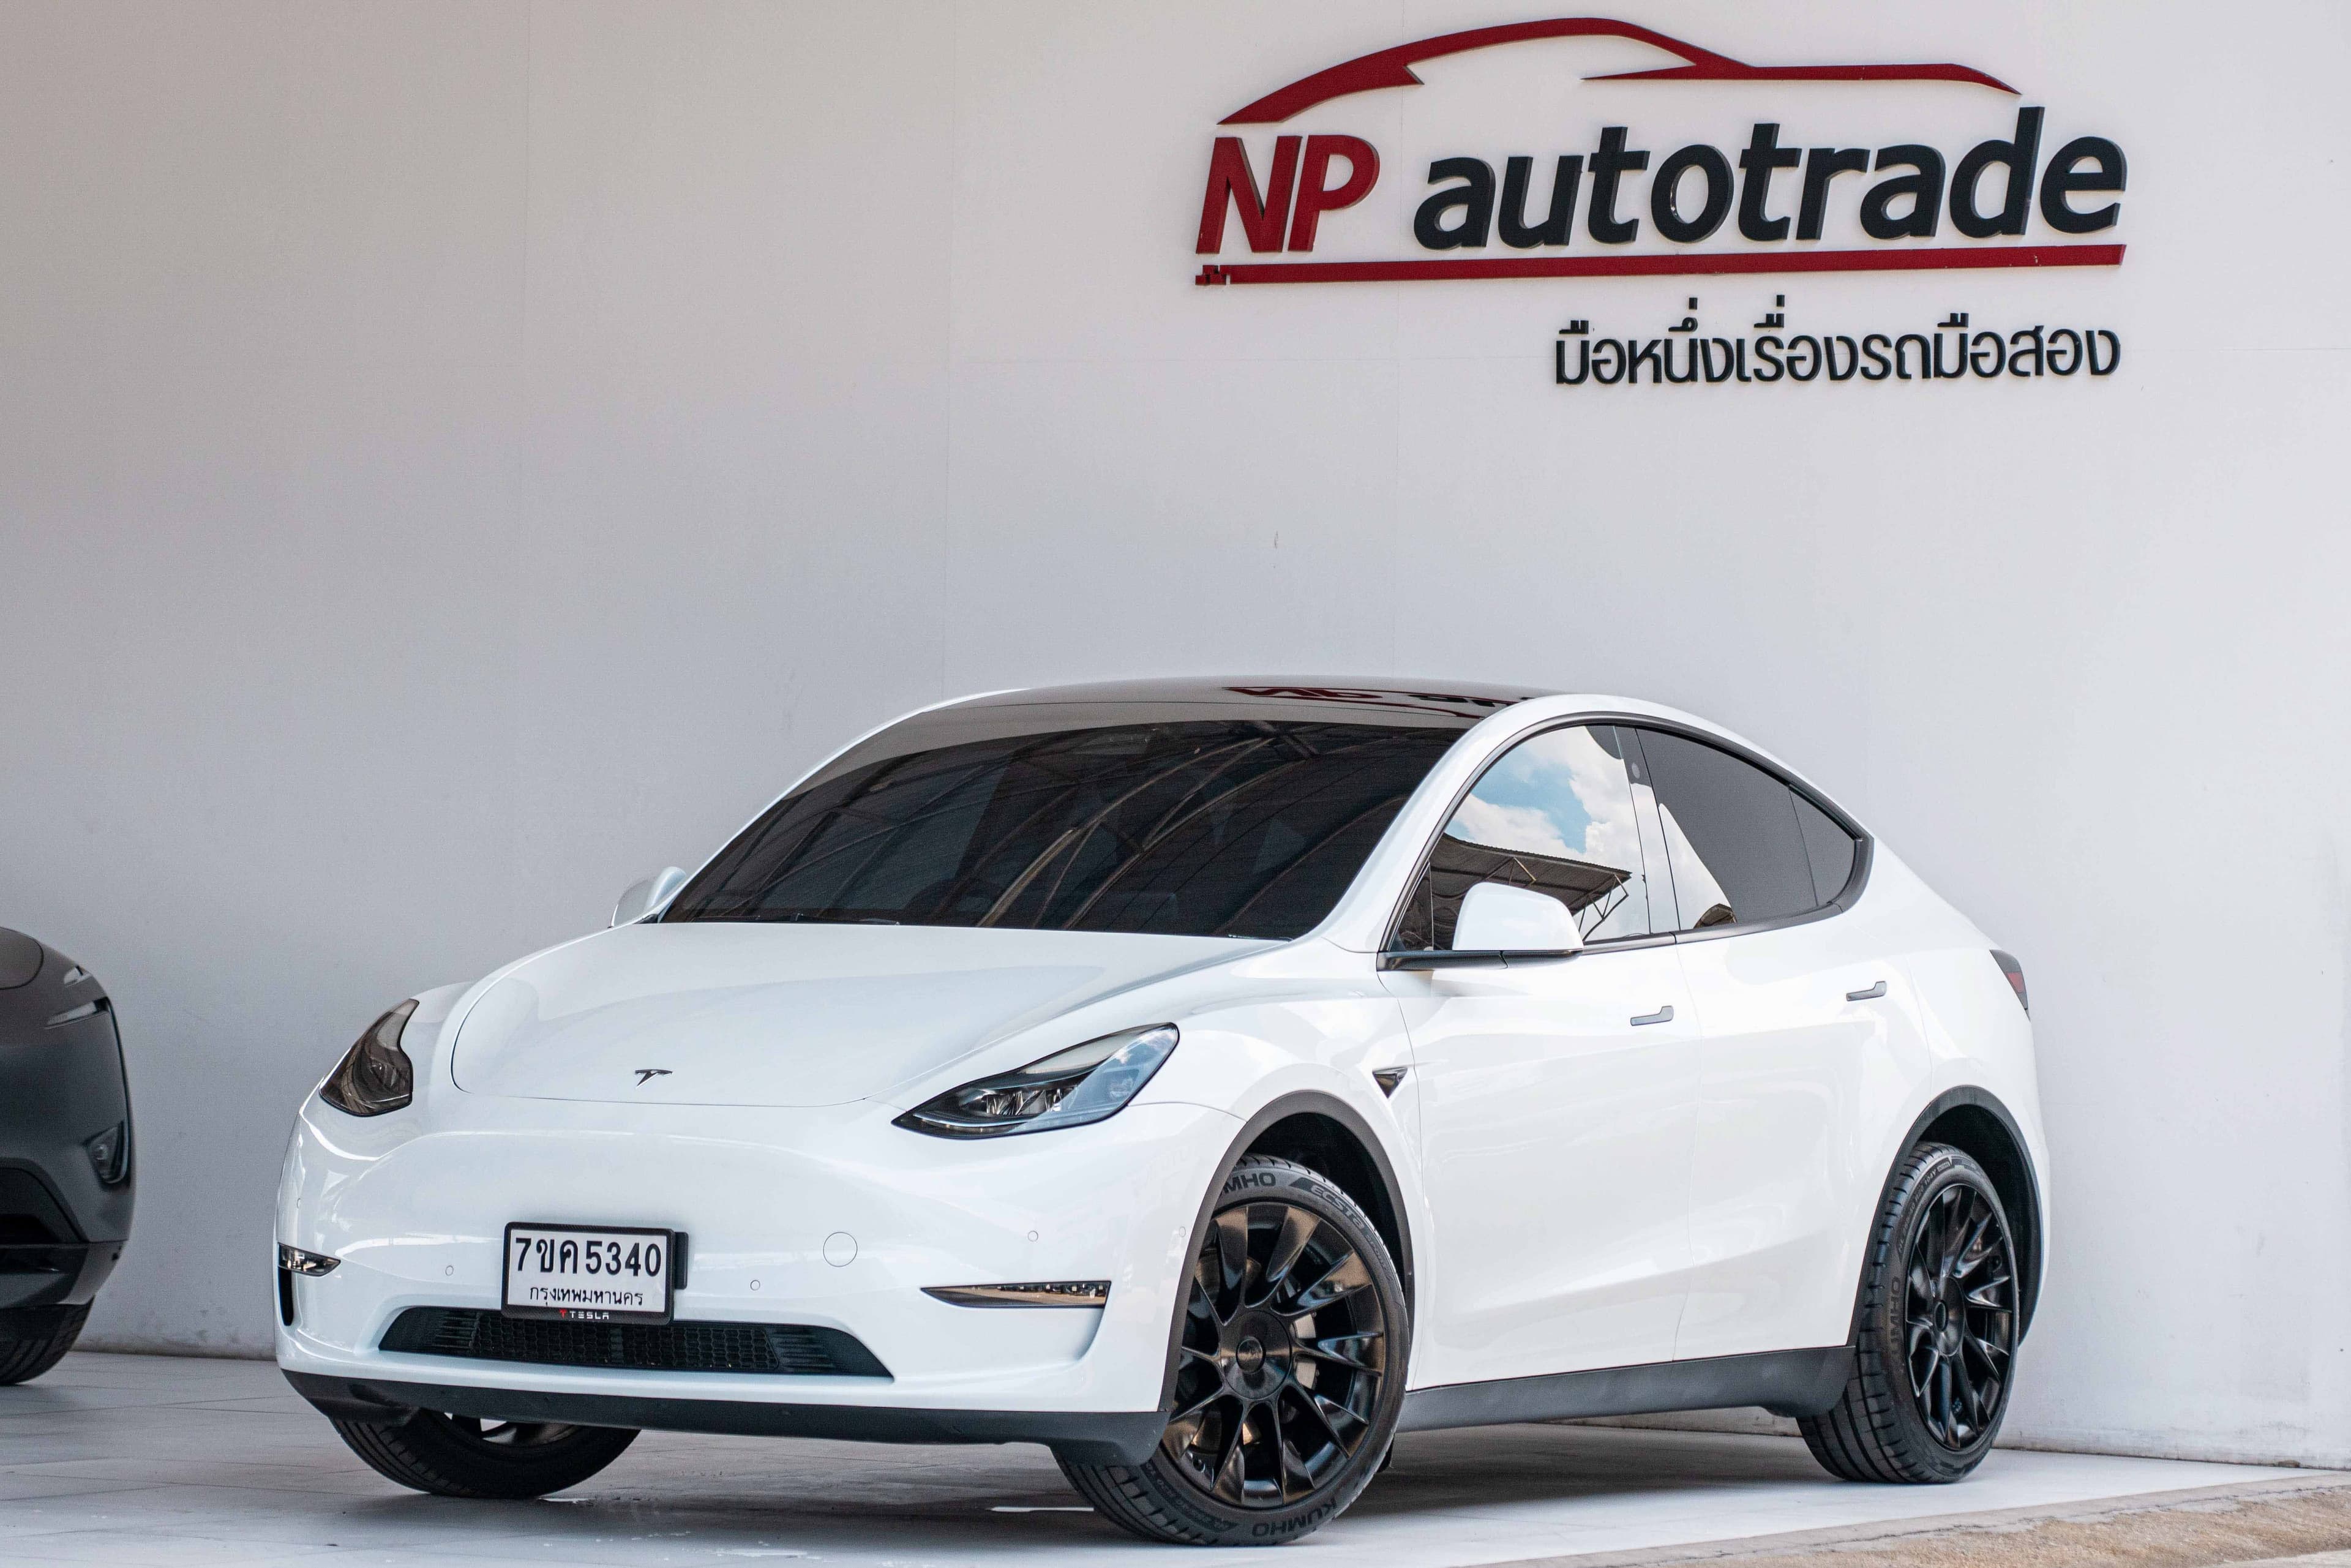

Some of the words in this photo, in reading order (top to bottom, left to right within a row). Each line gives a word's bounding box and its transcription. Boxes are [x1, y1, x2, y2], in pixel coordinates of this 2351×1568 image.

[1194, 134, 1381, 255] NP
[1413, 106, 2128, 250] autotrade
[1219, 1172, 1277, 1196] MHO
[585, 1240, 662, 1277] 5340
[530, 1286, 643, 1307] กรุงเทพมหานคร
[569, 1311, 610, 1320] TESLA
[1251, 1498, 1338, 1537] KUMHO
